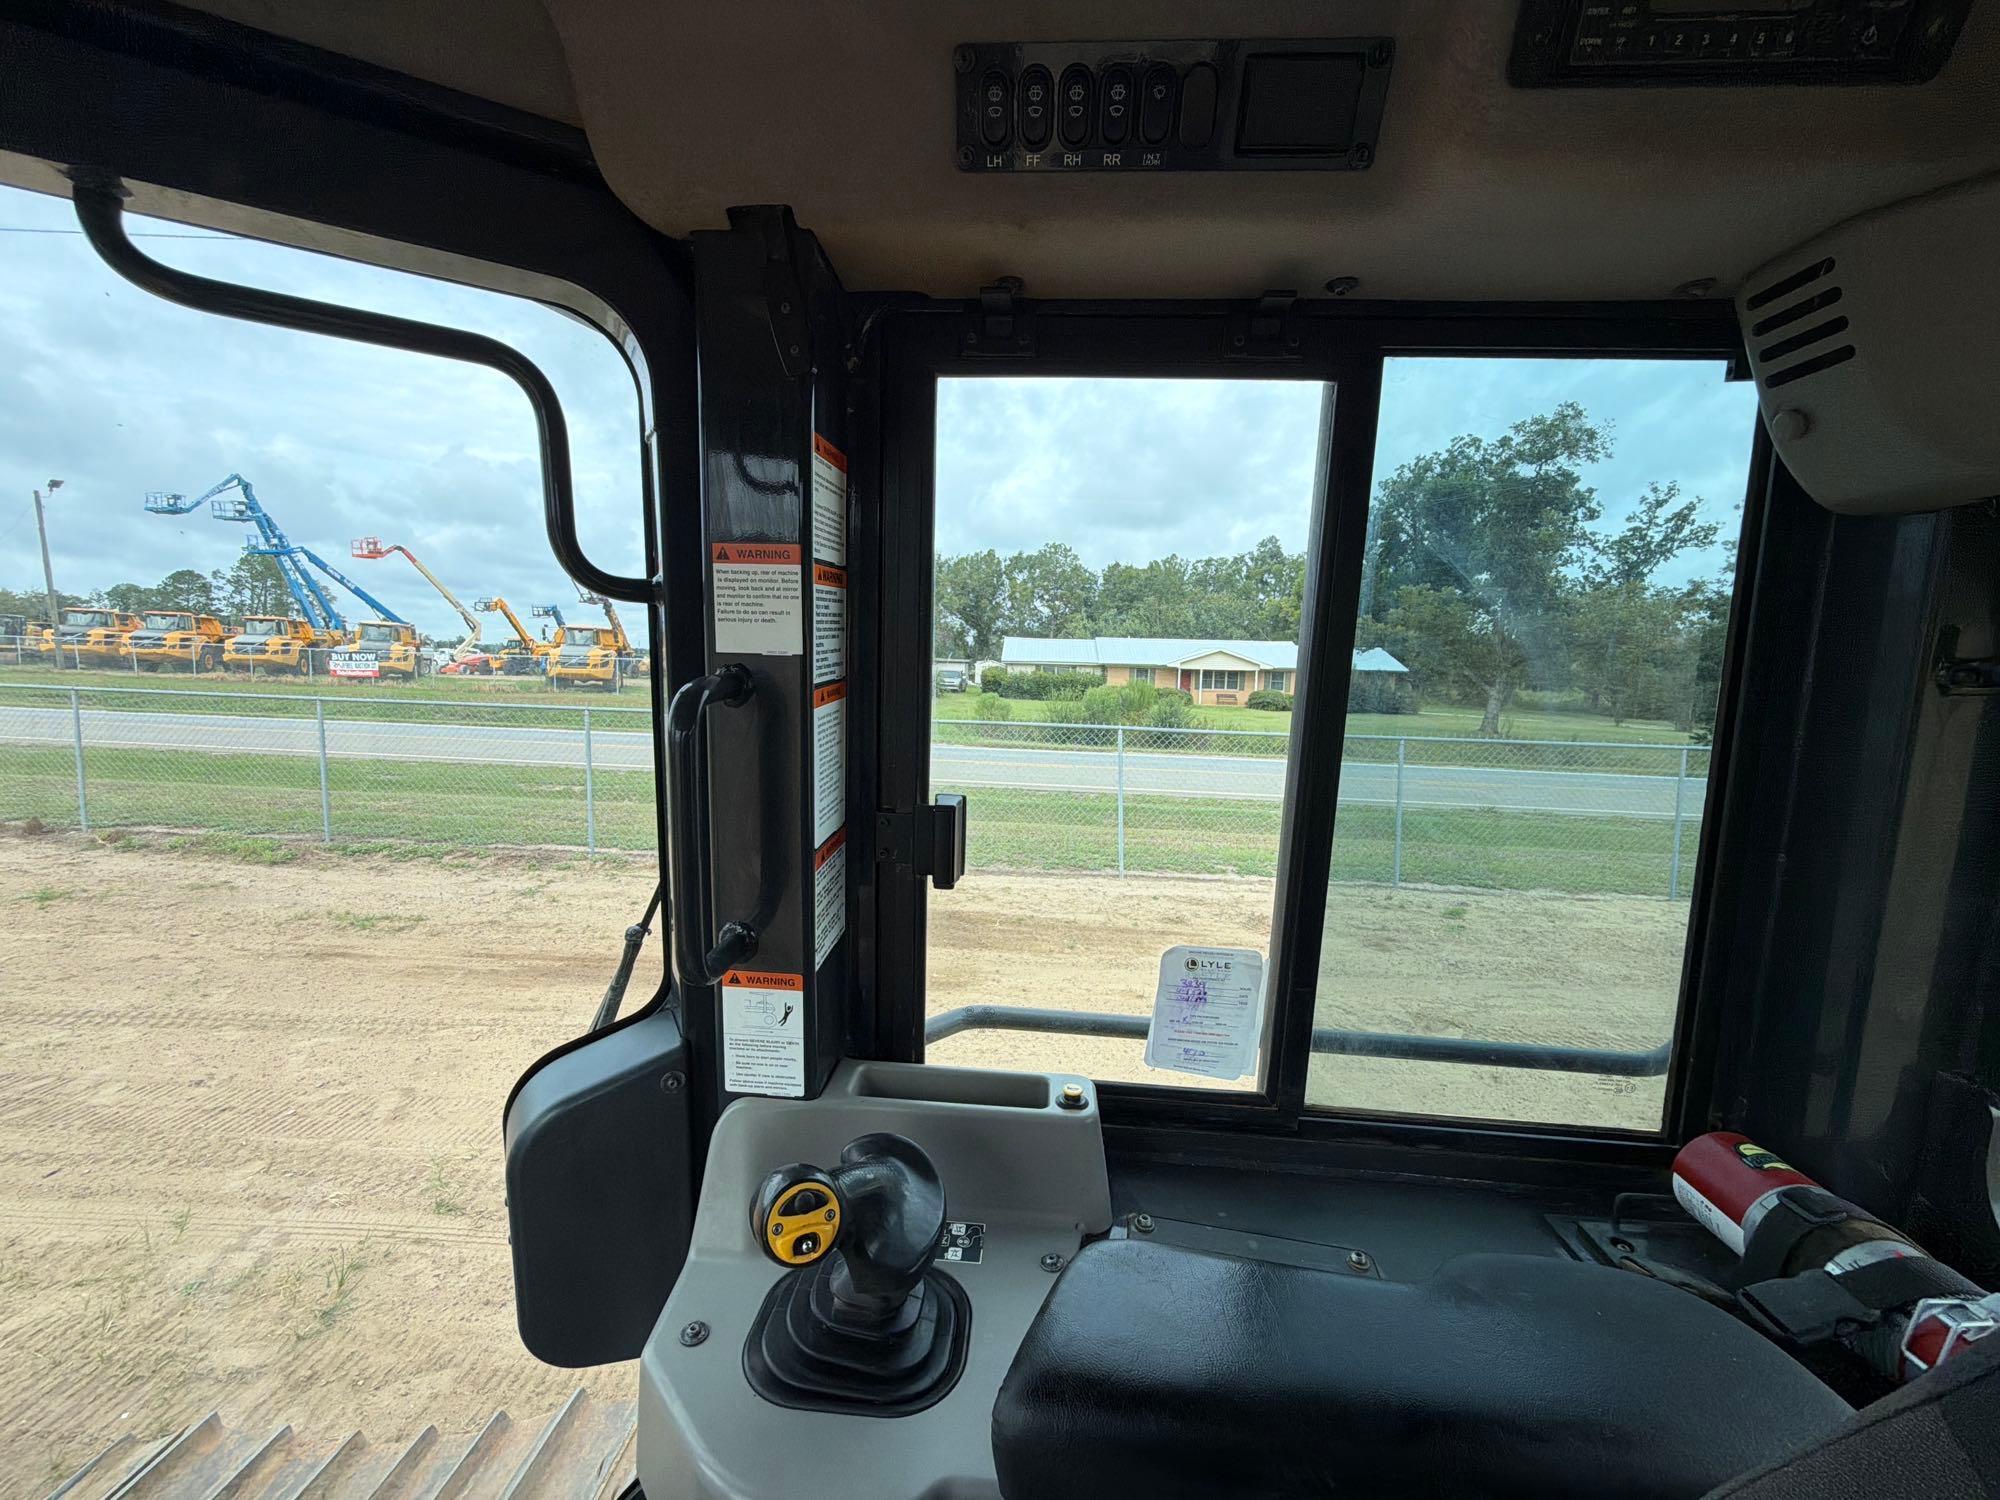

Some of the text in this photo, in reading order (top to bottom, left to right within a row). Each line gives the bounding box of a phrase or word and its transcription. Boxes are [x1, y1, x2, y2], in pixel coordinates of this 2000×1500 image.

[986, 155, 1002, 167] LH
[1026, 154, 1040, 167] FF
[1064, 154, 1082, 166] RH
[1104, 154, 1121, 166] RR
[736, 550, 790, 560] WARNING
[1201, 961, 1232, 969] LYLE
[746, 976, 796, 987] WARNING
